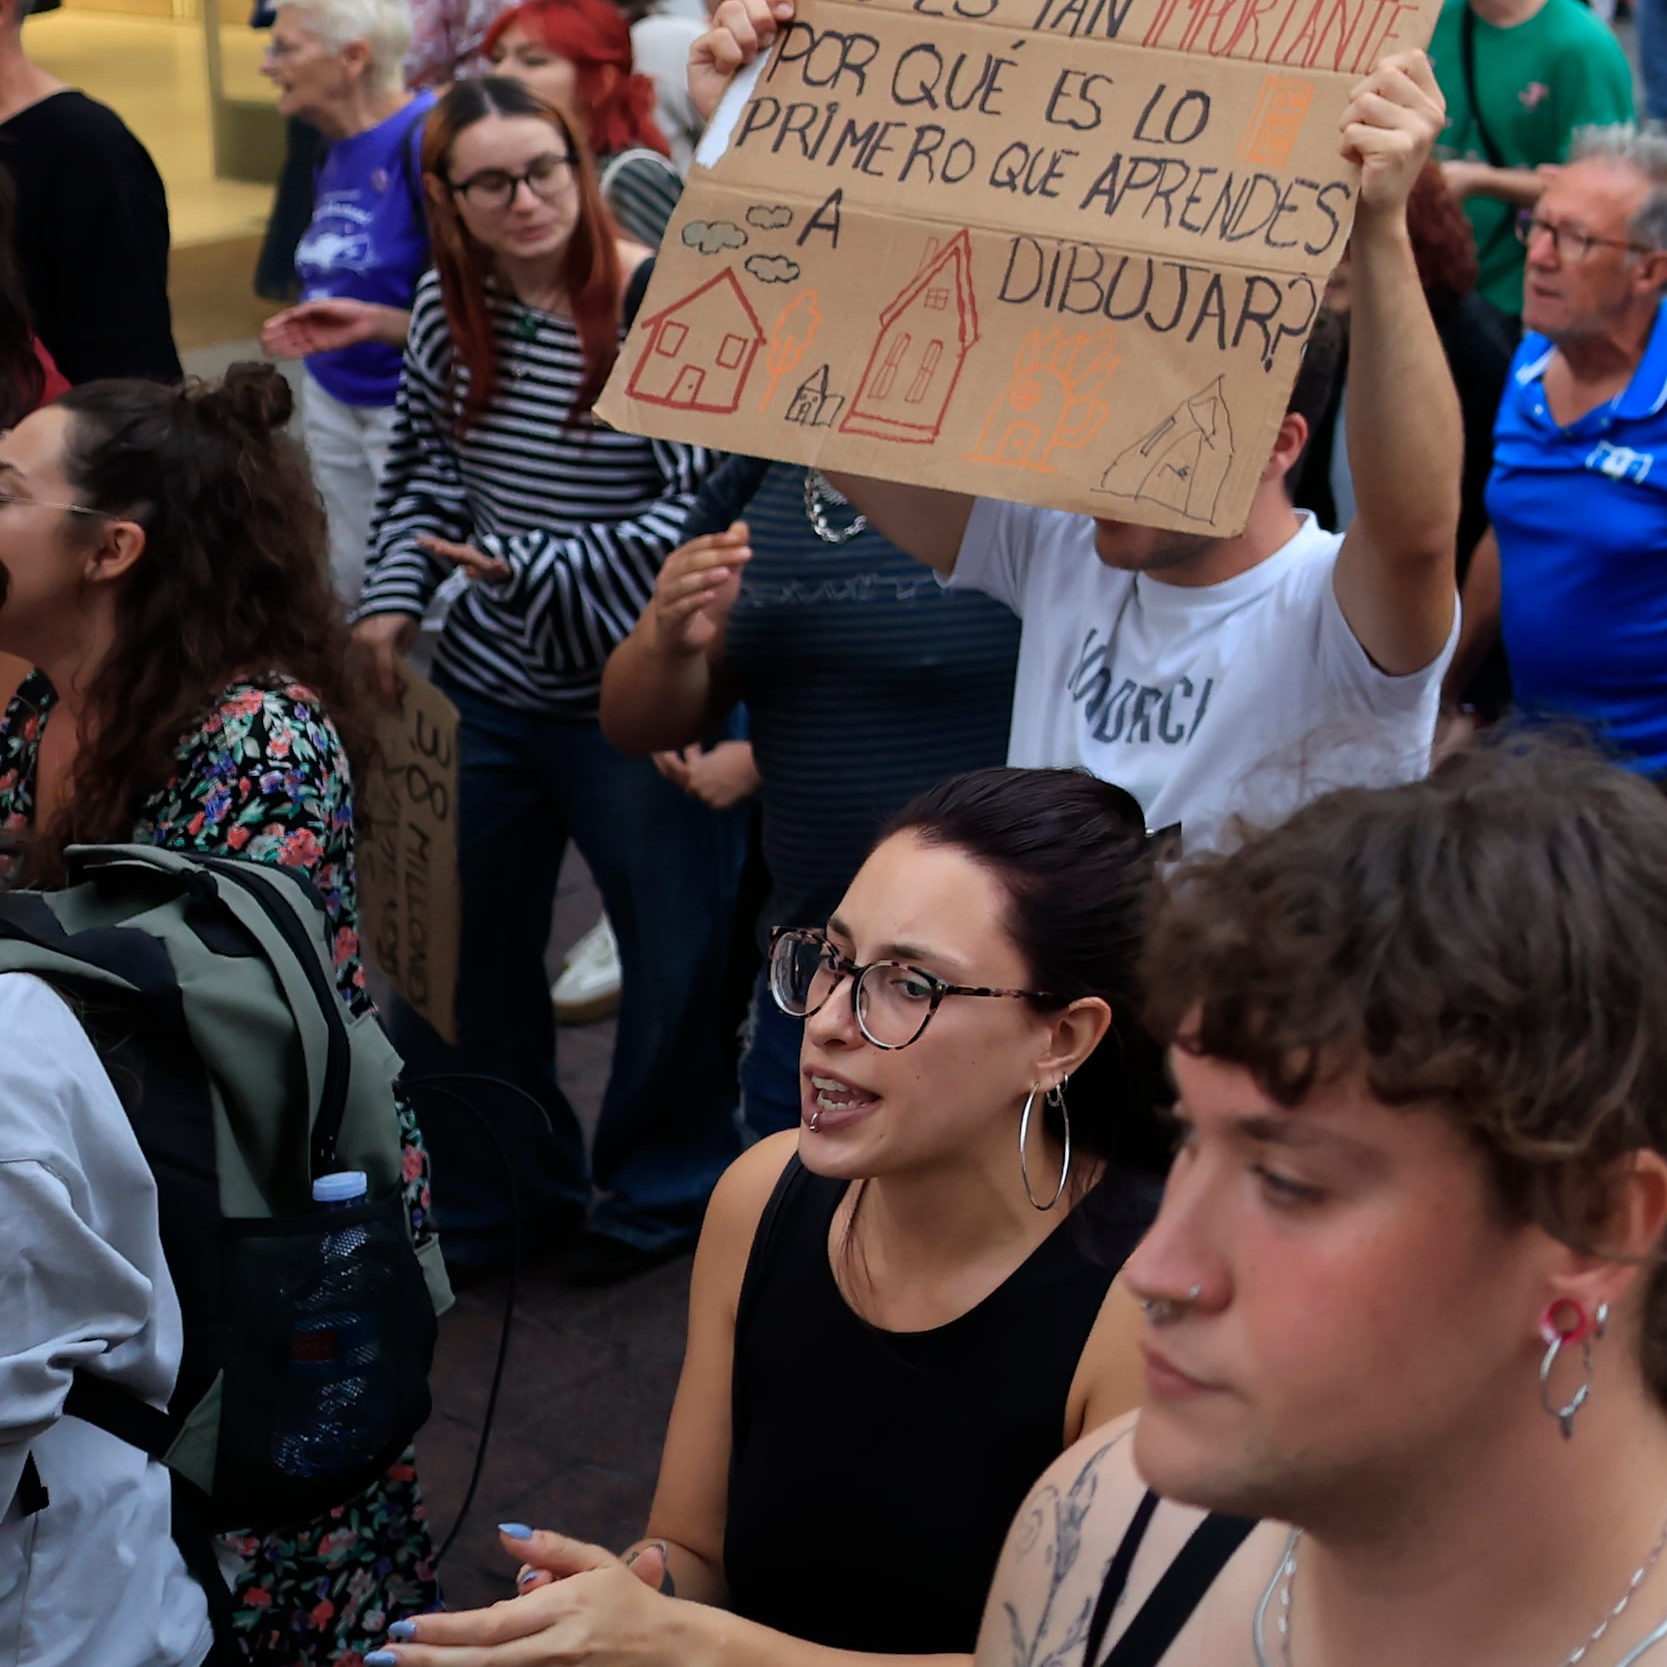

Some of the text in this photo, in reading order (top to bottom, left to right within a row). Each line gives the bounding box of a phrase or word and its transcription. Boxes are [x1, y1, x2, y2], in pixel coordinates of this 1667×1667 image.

[766, 21, 1212, 145] POR QUÉ ES LO
[734, 95, 1352, 257] PRIMERO QUE APRENDES
[795, 186, 1318, 374] A DIBUJAR?
